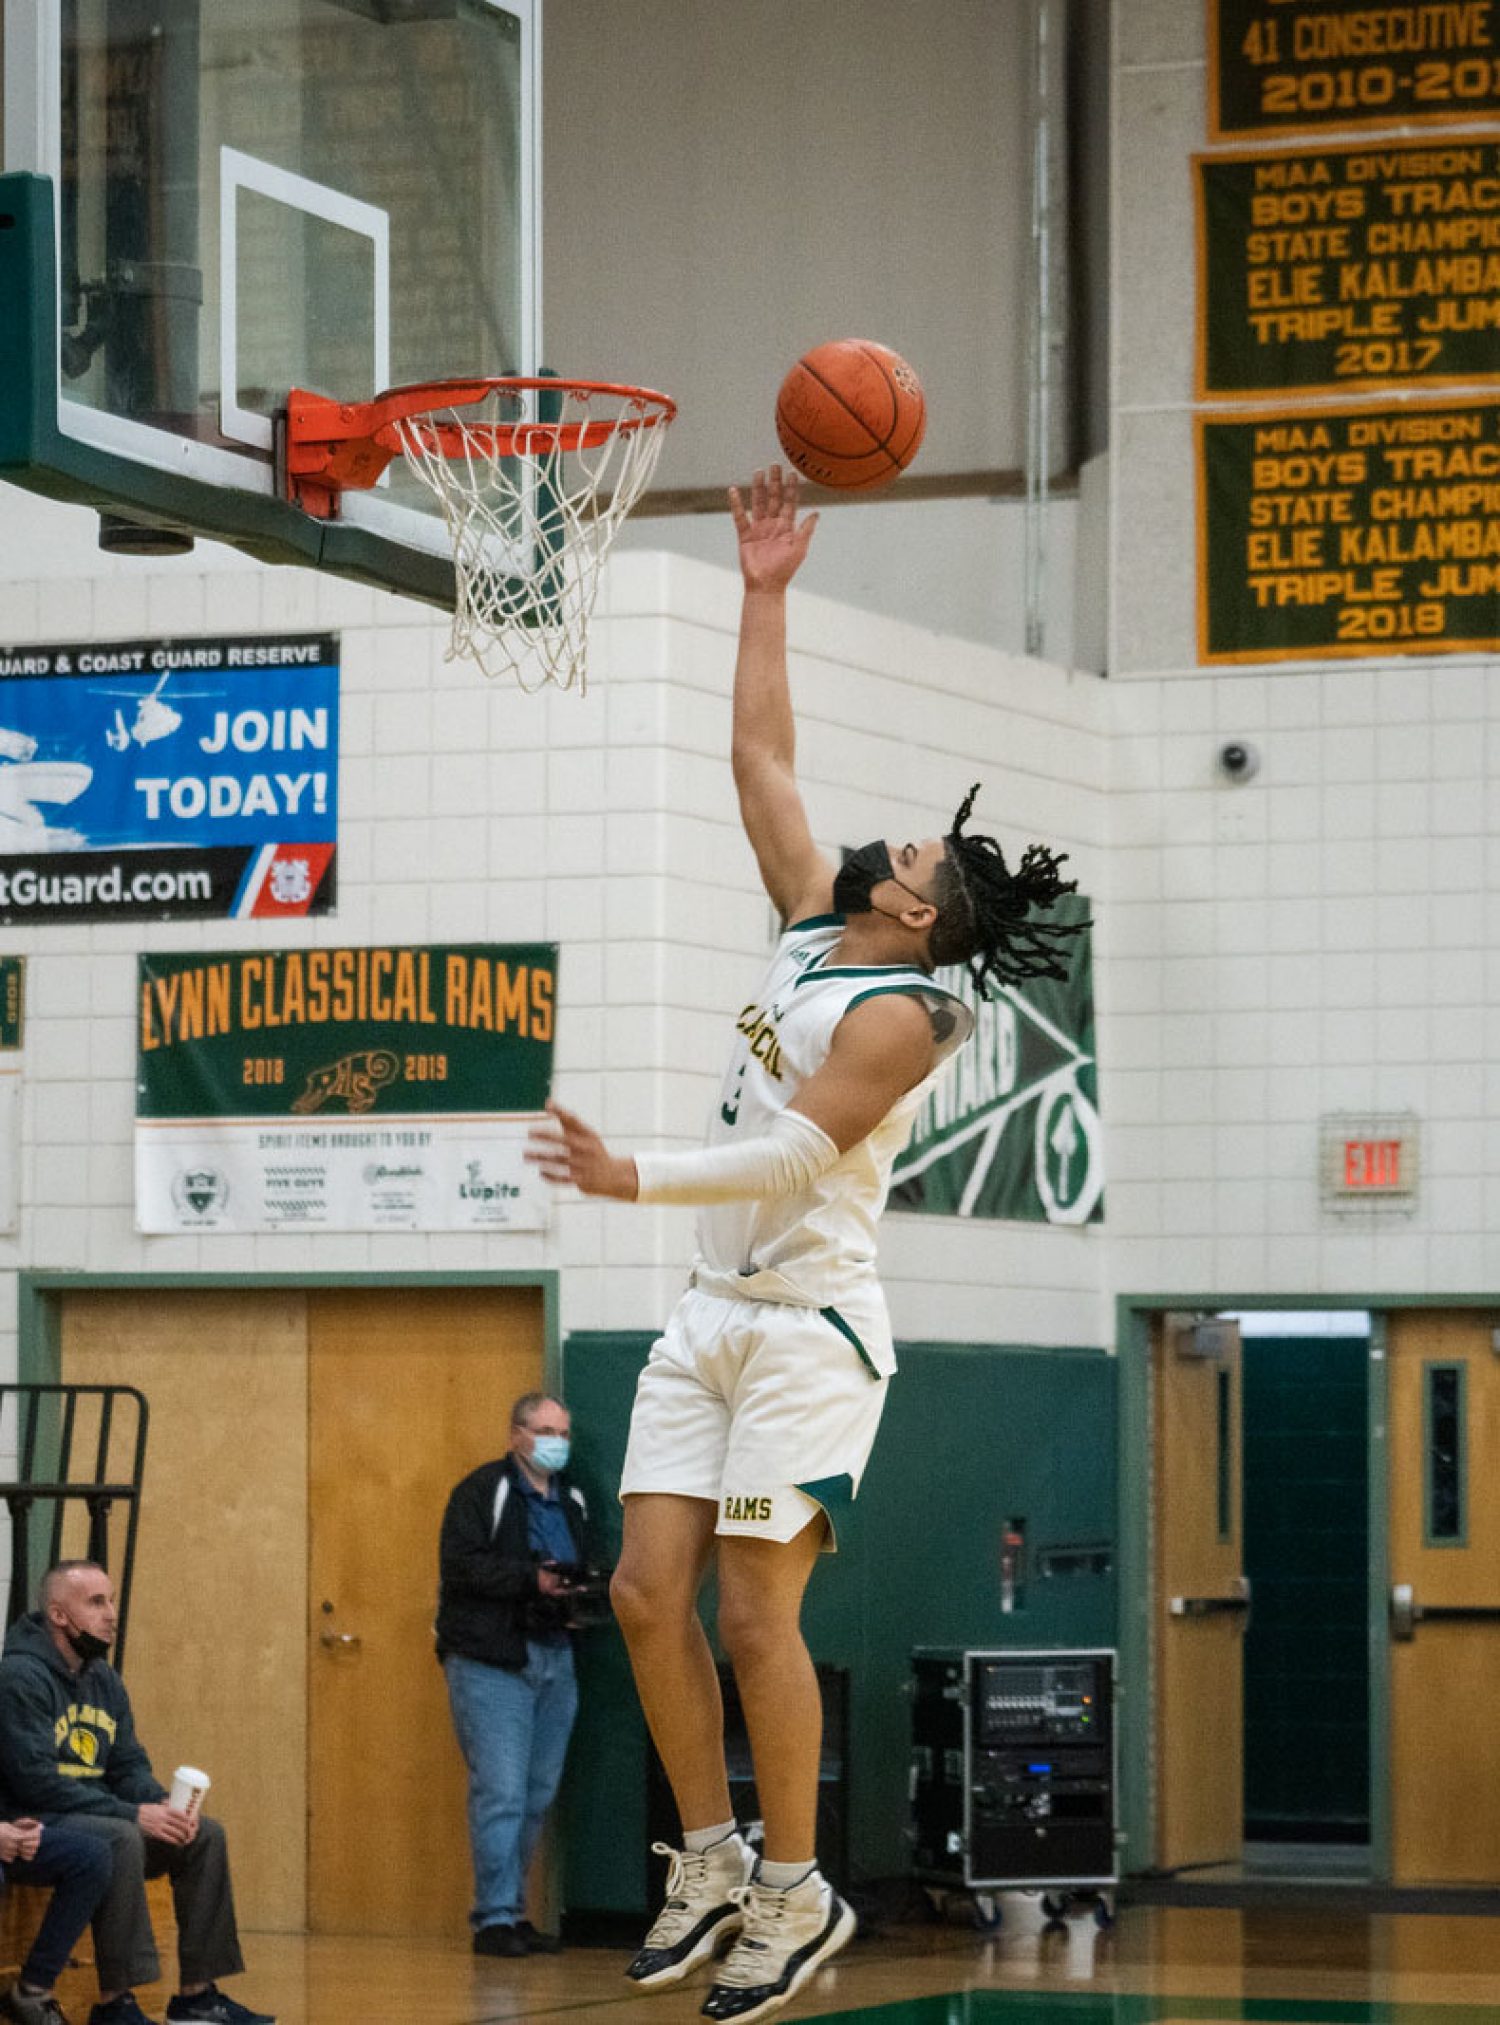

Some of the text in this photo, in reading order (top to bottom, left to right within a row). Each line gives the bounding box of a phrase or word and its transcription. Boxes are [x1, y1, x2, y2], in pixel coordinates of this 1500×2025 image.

[1242, 3, 1492, 65] 41 CONSECUTIVE
[1255, 162, 1332, 190] MIAA
[1346, 150, 1482, 182] DIVISION
[1252, 179, 1500, 226] BOYS TRAC
[1247, 227, 1349, 263] STATE
[1248, 265, 1323, 308] ELIE
[1249, 304, 1402, 344] TRIPLE
[1335, 338, 1441, 374] 2017
[1255, 426, 1331, 453] MIAA
[1349, 415, 1482, 447] DIVISION
[1253, 444, 1500, 489] BOYS TRAC
[1250, 492, 1353, 527] STATE
[1247, 529, 1323, 570] ELIE
[1248, 569, 1402, 608] TRIPLE
[1337, 604, 1445, 640] 2018
[55, 656, 71, 674] &
[78, 653, 145, 673] COAST
[152, 649, 221, 669] GUARD
[228, 645, 320, 666] RESERVE
[199, 708, 328, 754] JOIN
[134, 772, 328, 819] TODAY!
[141, 949, 554, 1052] LYNN CLASSICAL RAMS
[242, 1055, 448, 1085] 2018 2019
[1345, 1140, 1401, 1185] EXIT
